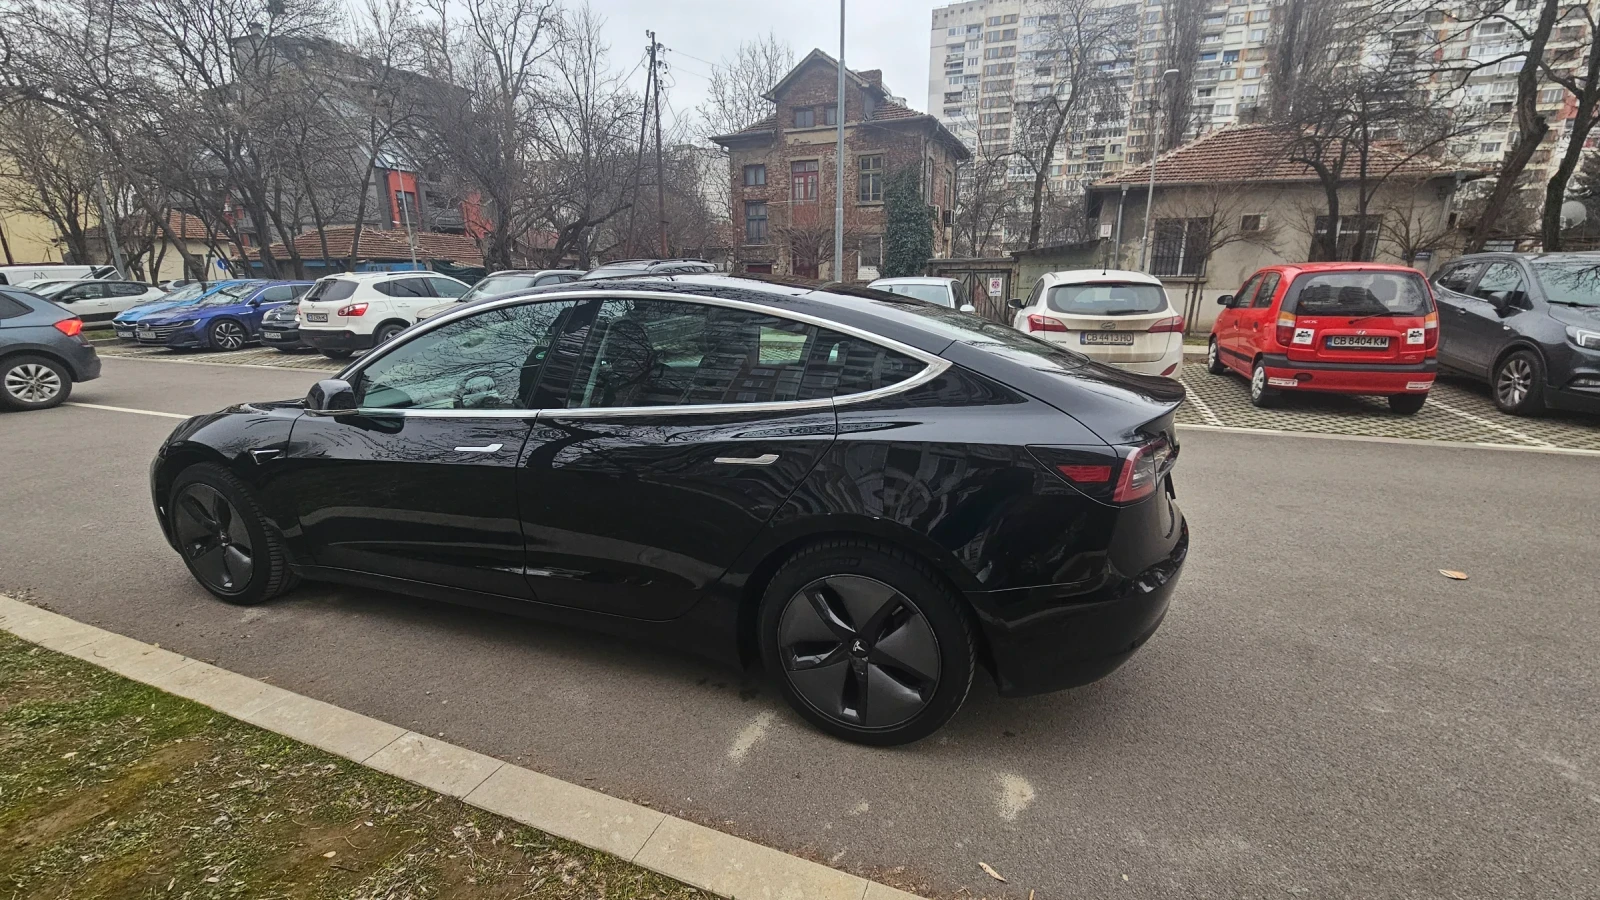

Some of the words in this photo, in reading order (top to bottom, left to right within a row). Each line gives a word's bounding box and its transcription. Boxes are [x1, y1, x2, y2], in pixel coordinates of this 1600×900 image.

[1099, 333, 1119, 342] 4413
[1333, 336, 1347, 345] CB
[1348, 336, 1372, 346] 8404
[1373, 337, 1388, 346] KM
